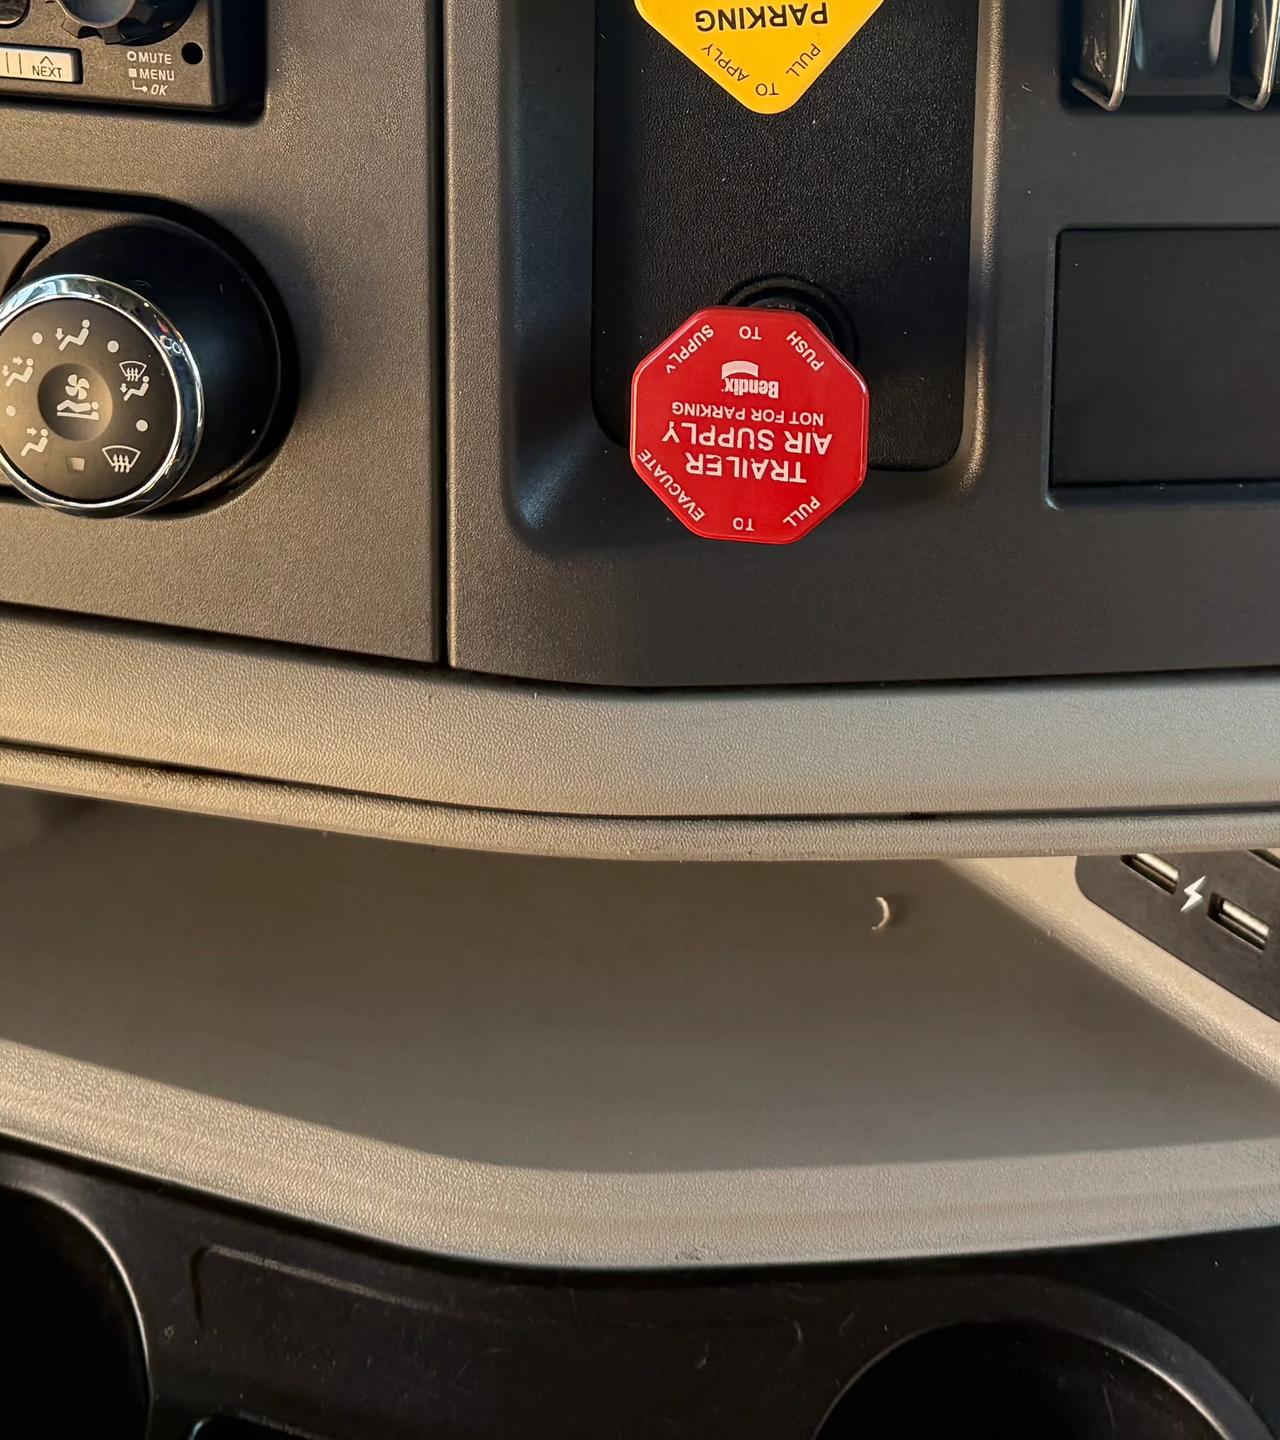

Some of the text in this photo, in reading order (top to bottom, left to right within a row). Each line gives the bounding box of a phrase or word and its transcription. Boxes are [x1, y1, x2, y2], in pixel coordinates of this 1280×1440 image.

[695, 2, 828, 32] PARKING
[32, 64, 63, 78] NEXT
[138, 51, 172, 65] MUTE
[701, 43, 821, 96] PULL TO APPLY
[139, 68, 175, 81] MENU
[151, 83, 168, 96] OK
[738, 325, 762, 340] TO
[785, 329, 825, 372] PUSH
[724, 377, 779, 399] Bendix
[671, 401, 824, 427] NOT FOR PARKING
[661, 420, 833, 456] AIR SUPPLY
[685, 452, 807, 484] TRAILER
[637, 448, 821, 532] PULL TO EVACUATE
